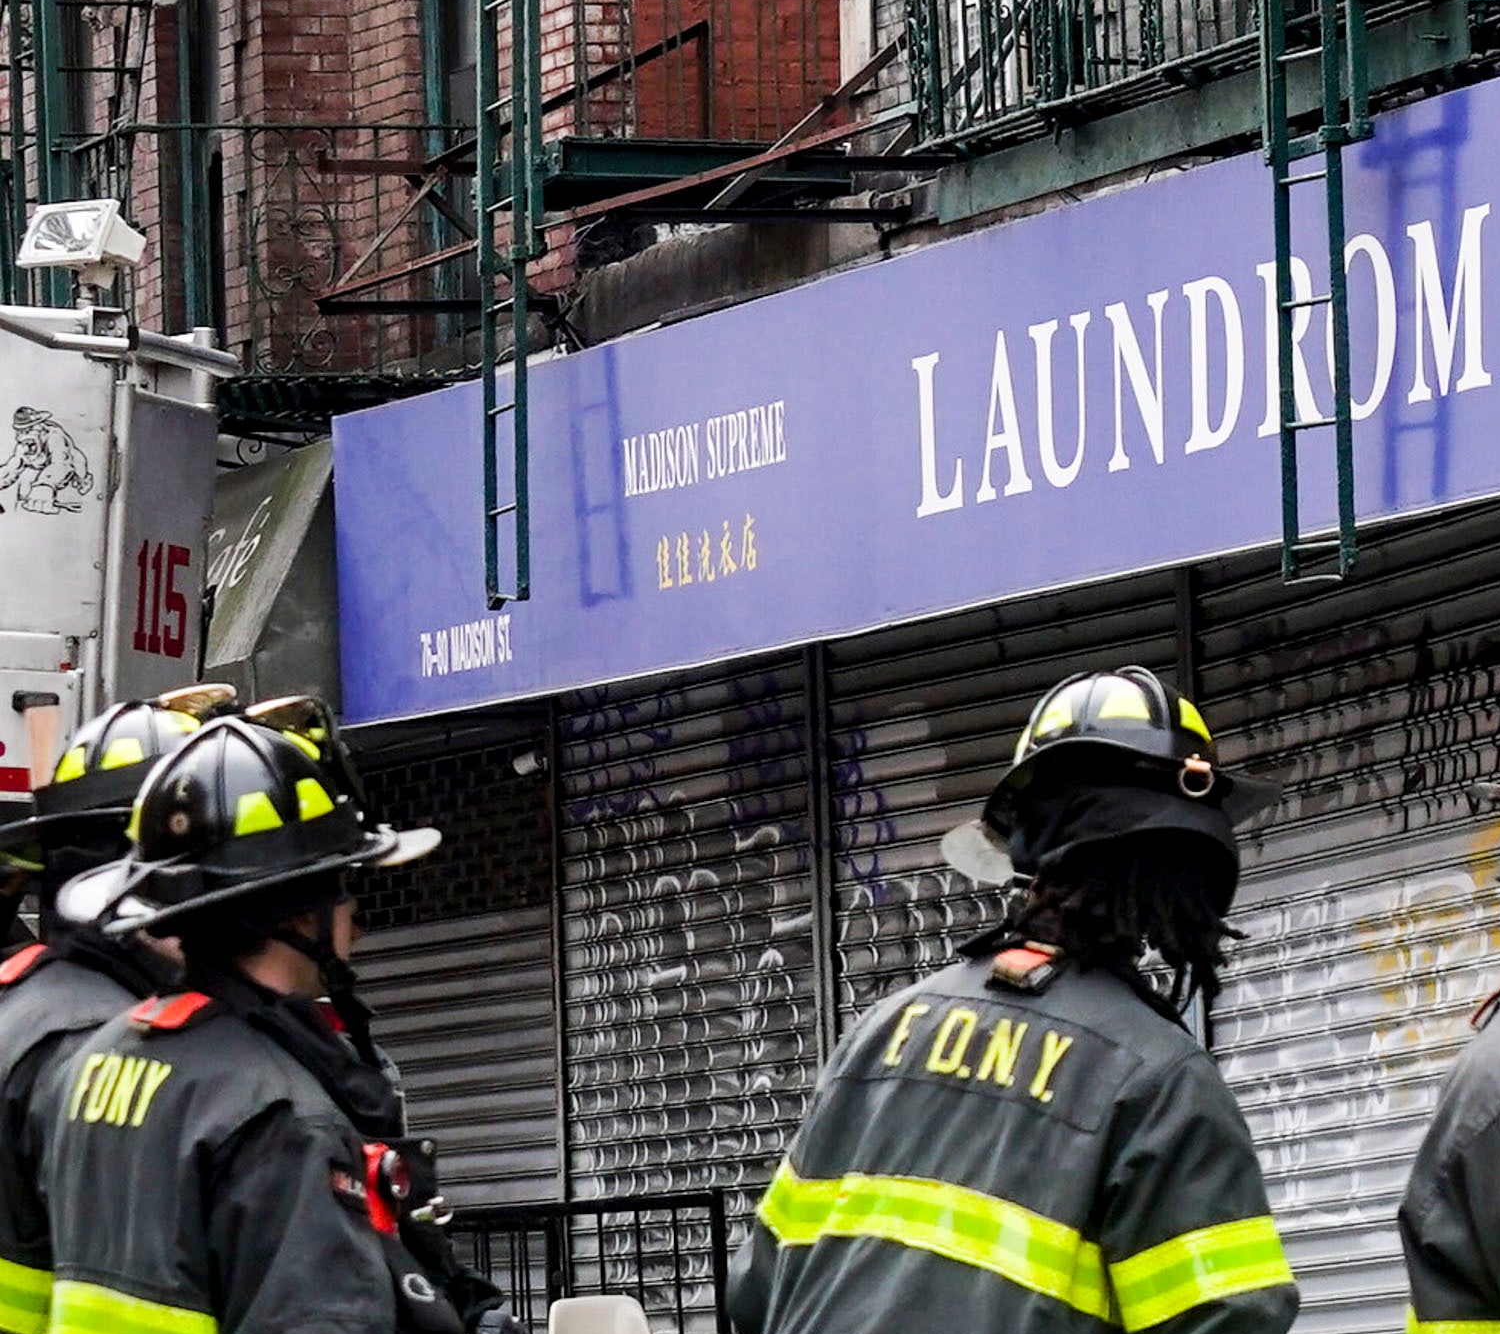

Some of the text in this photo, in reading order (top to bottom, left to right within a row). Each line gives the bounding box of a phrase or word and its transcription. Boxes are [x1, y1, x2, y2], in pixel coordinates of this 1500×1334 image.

[623, 400, 787, 498] MADISON SUPREME
[133, 539, 191, 660] 115
[450, 618, 495, 673] MADISON
[497, 614, 513, 664] ST.
[68, 1053, 173, 1128] FDNY
